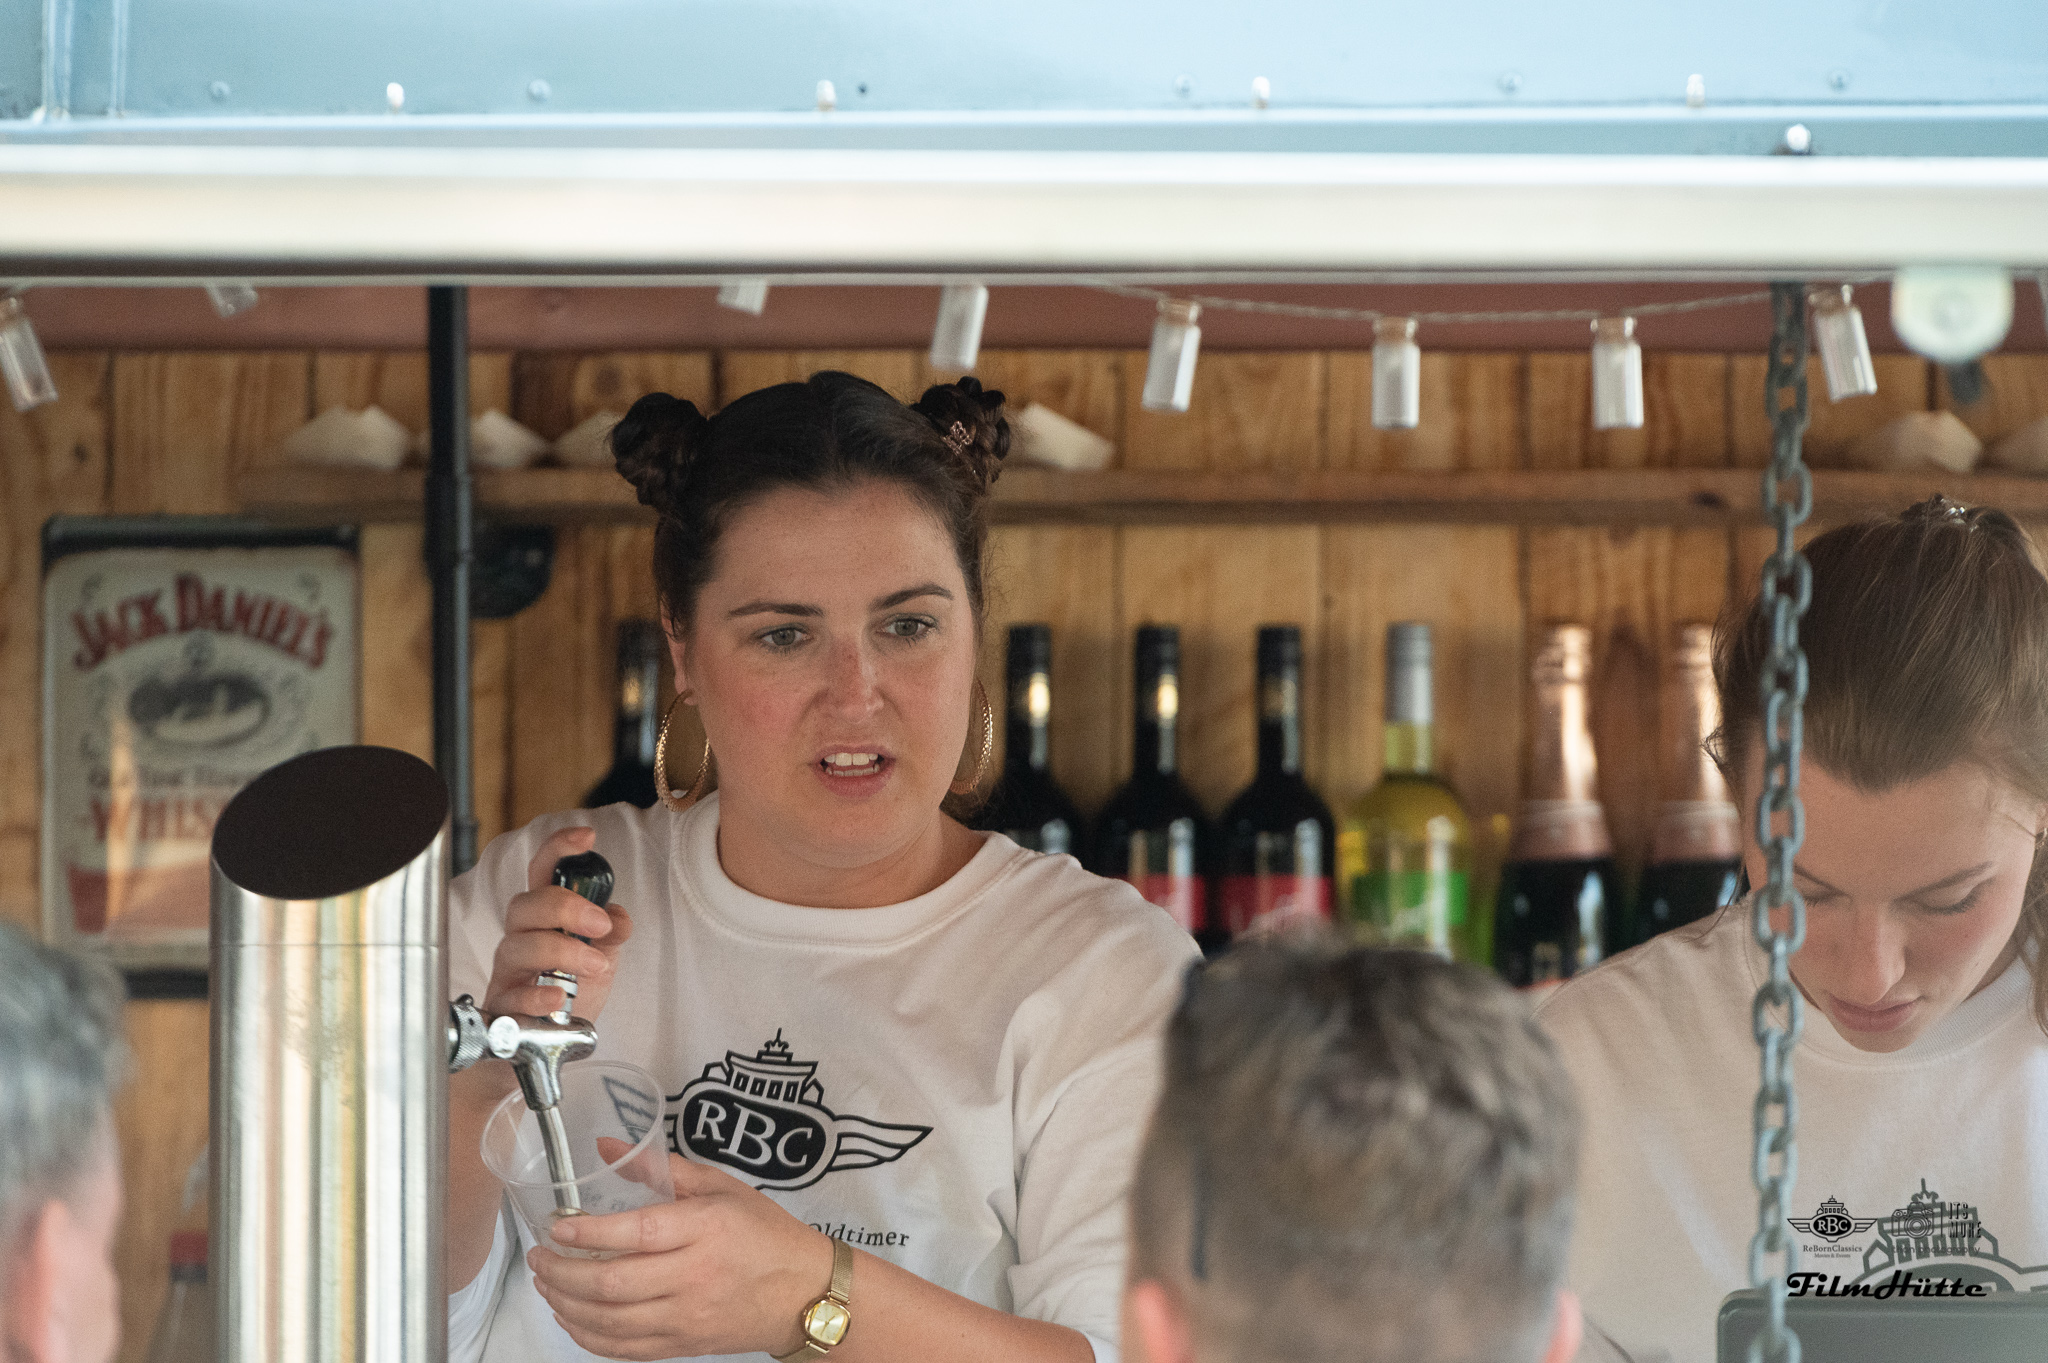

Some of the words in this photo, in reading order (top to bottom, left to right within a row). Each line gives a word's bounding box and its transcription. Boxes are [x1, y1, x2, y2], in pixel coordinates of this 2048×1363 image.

[72, 588, 168, 670] JACK
[90, 798, 224, 841] WHIS
[691, 1098, 813, 1169] RBC
